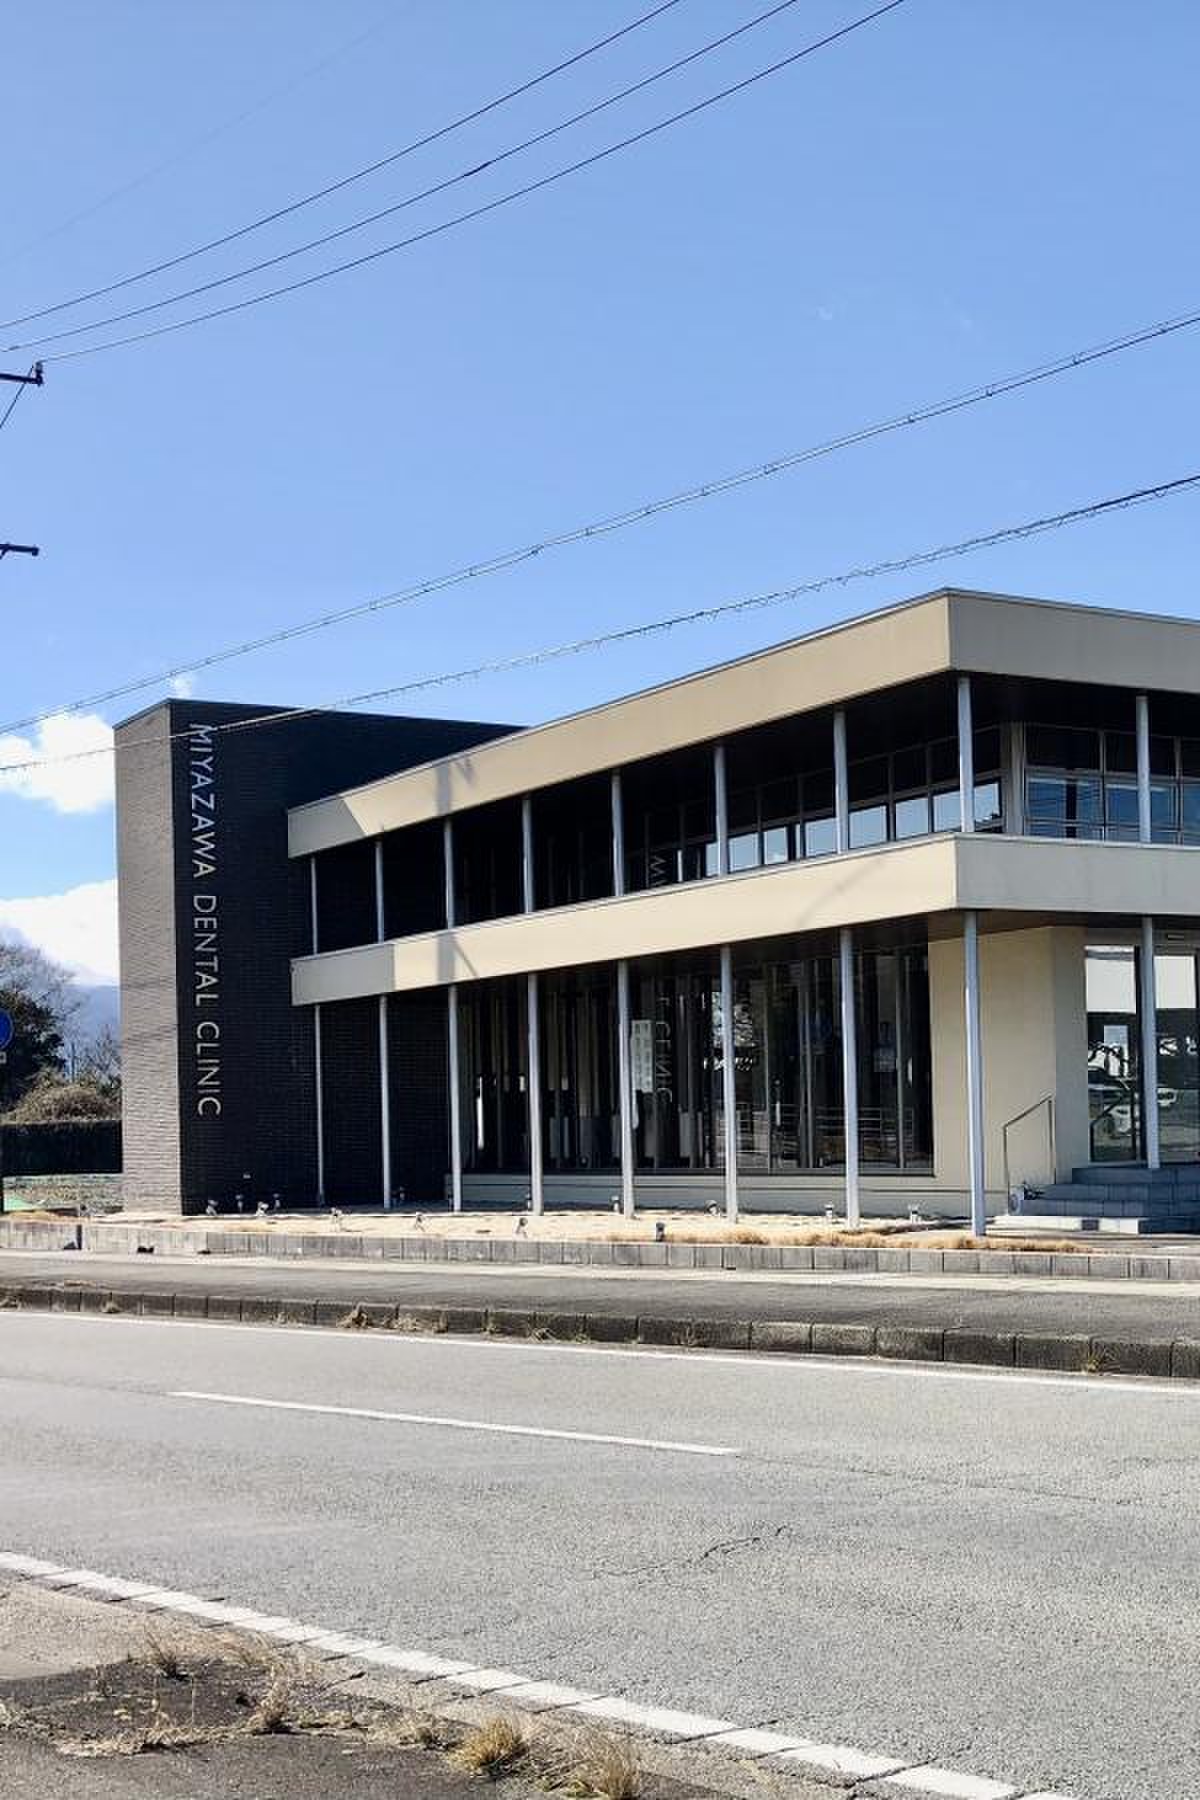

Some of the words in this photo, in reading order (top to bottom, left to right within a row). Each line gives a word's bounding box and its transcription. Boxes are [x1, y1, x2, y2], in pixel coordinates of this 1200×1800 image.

[189, 723, 217, 878] MIYAZAWA
[193, 895, 219, 1007] DENTAL
[196, 1021, 222, 1115] CLINIC
